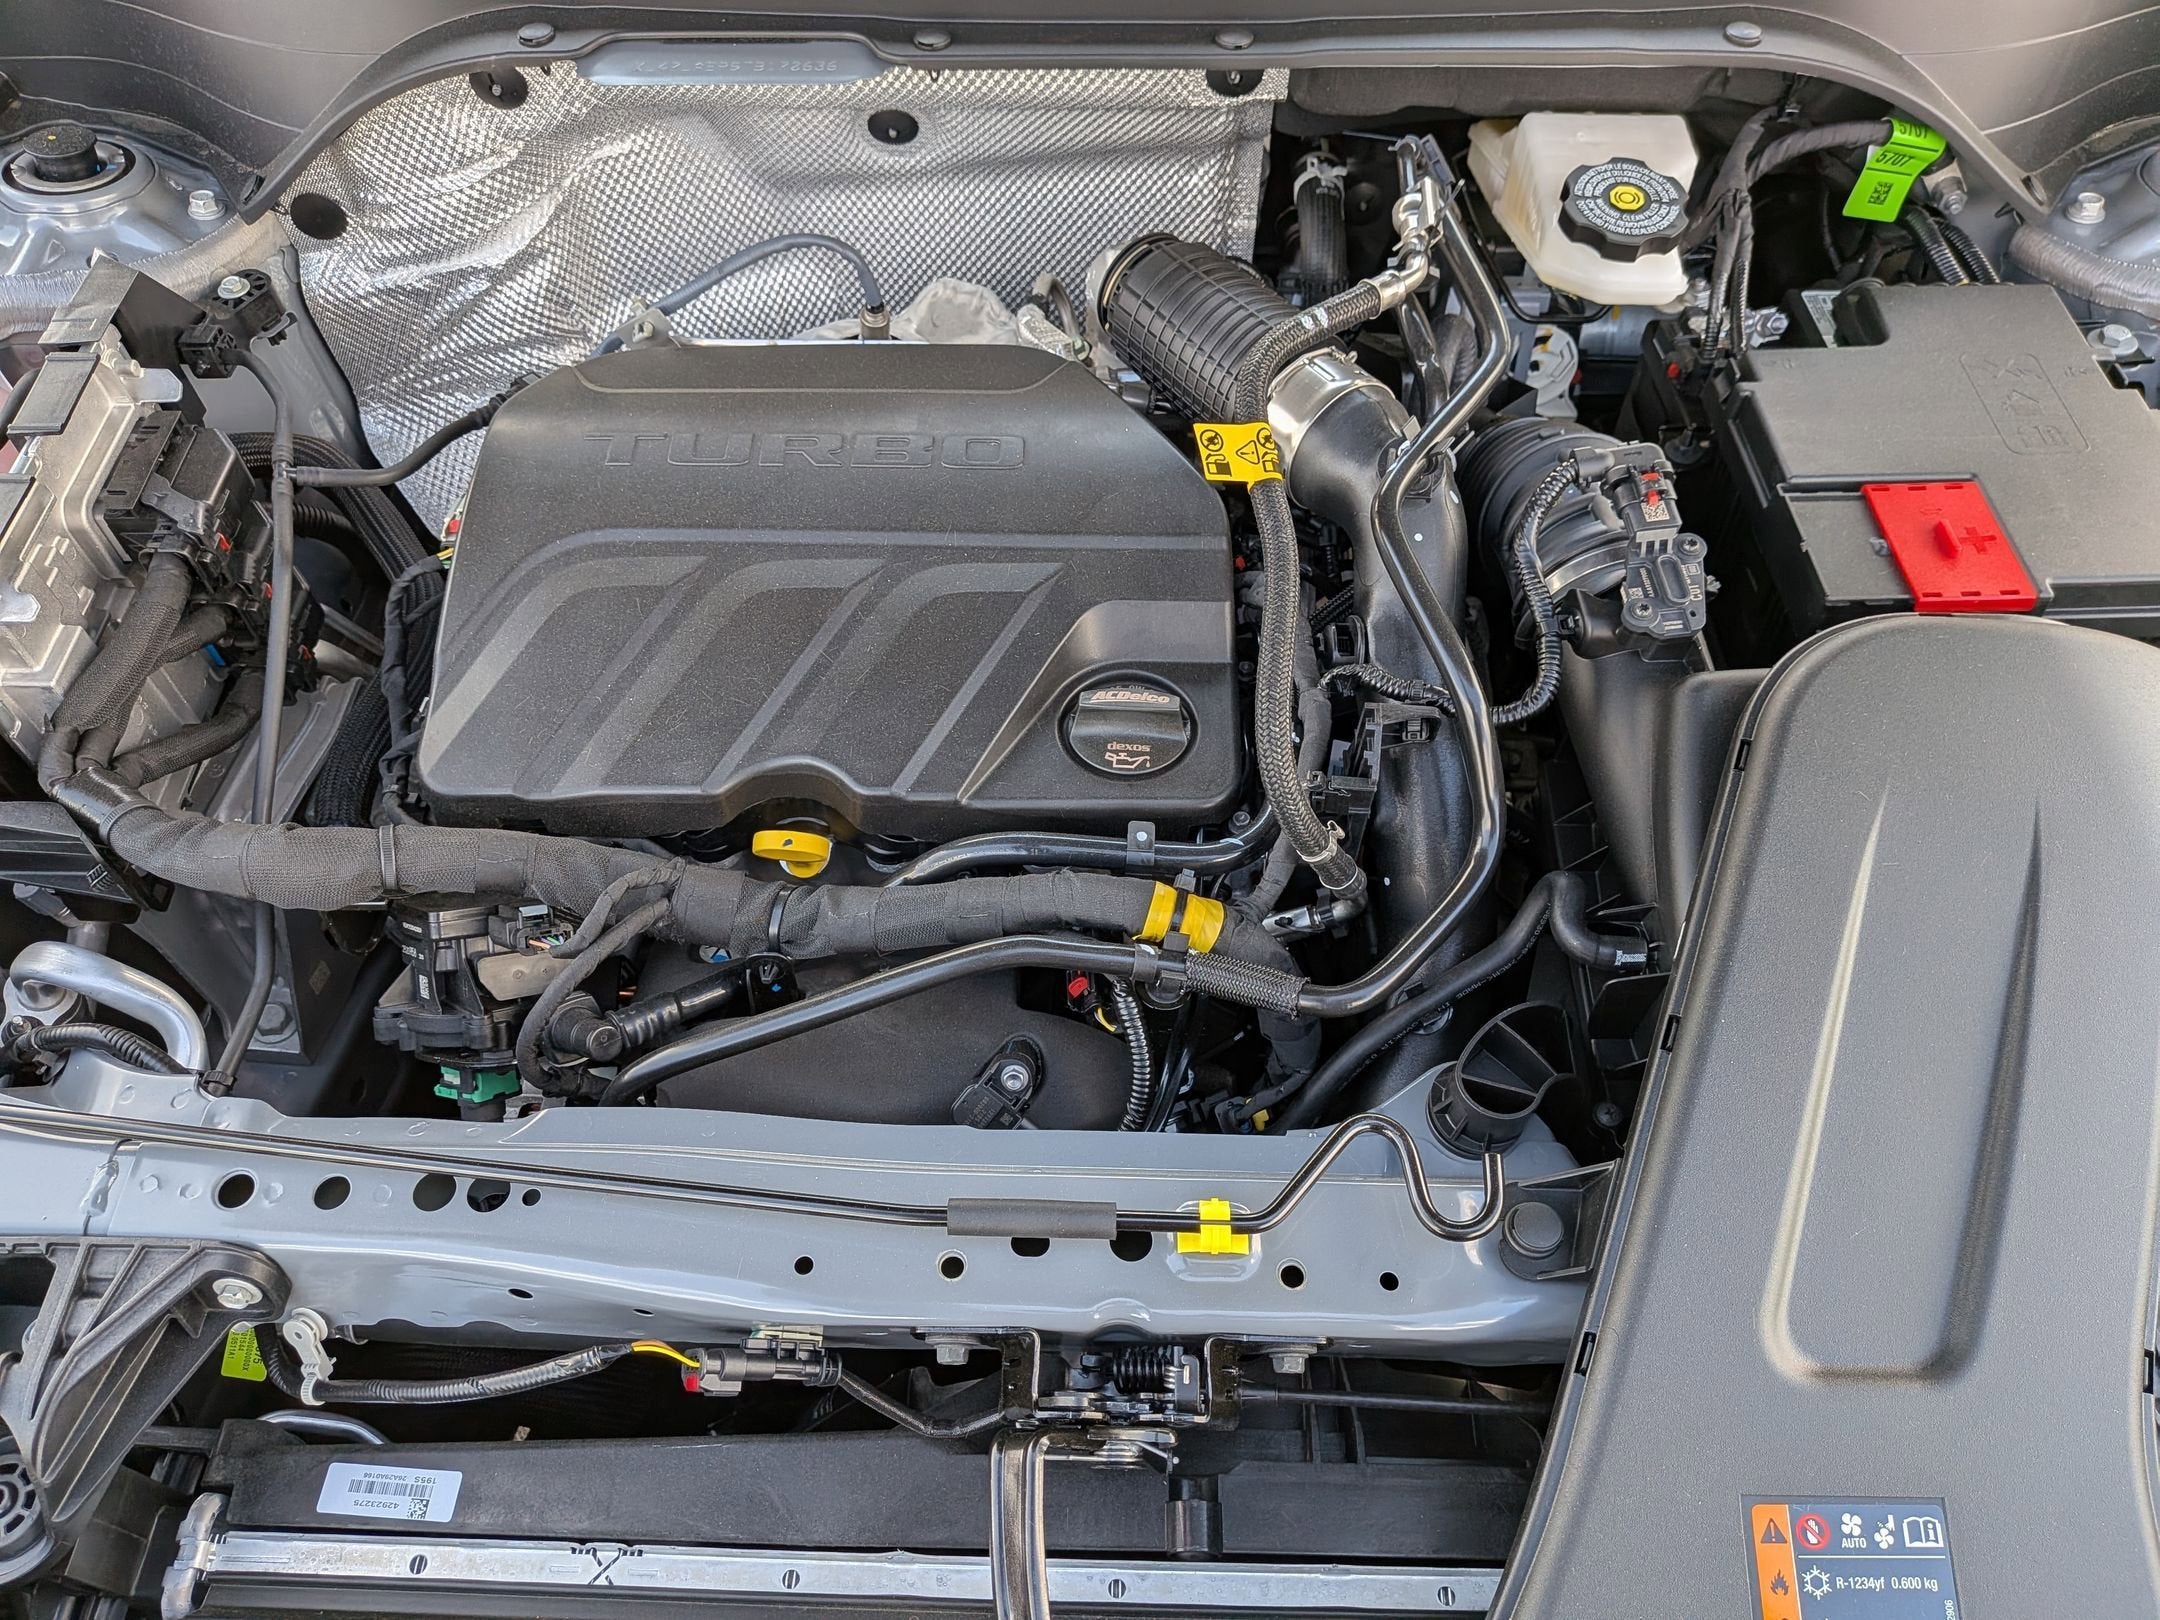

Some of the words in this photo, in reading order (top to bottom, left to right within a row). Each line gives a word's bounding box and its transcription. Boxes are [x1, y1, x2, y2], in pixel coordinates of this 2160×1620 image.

[1875, 150, 1916, 168] 5707
[1603, 223, 1624, 234] FROM
[583, 433, 1025, 470] TURBO
[1091, 691, 1171, 704] ACDelco
[1107, 741, 1152, 752] dexos
[414, 1475, 437, 1485] 195S
[353, 1499, 400, 1510] 42923275
[1841, 1537, 1867, 1549] AUTO
[1836, 1576, 1885, 1592] R-1234yf
[1891, 1577, 1922, 1590] 0.600
[1924, 1576, 1939, 1592] kg
